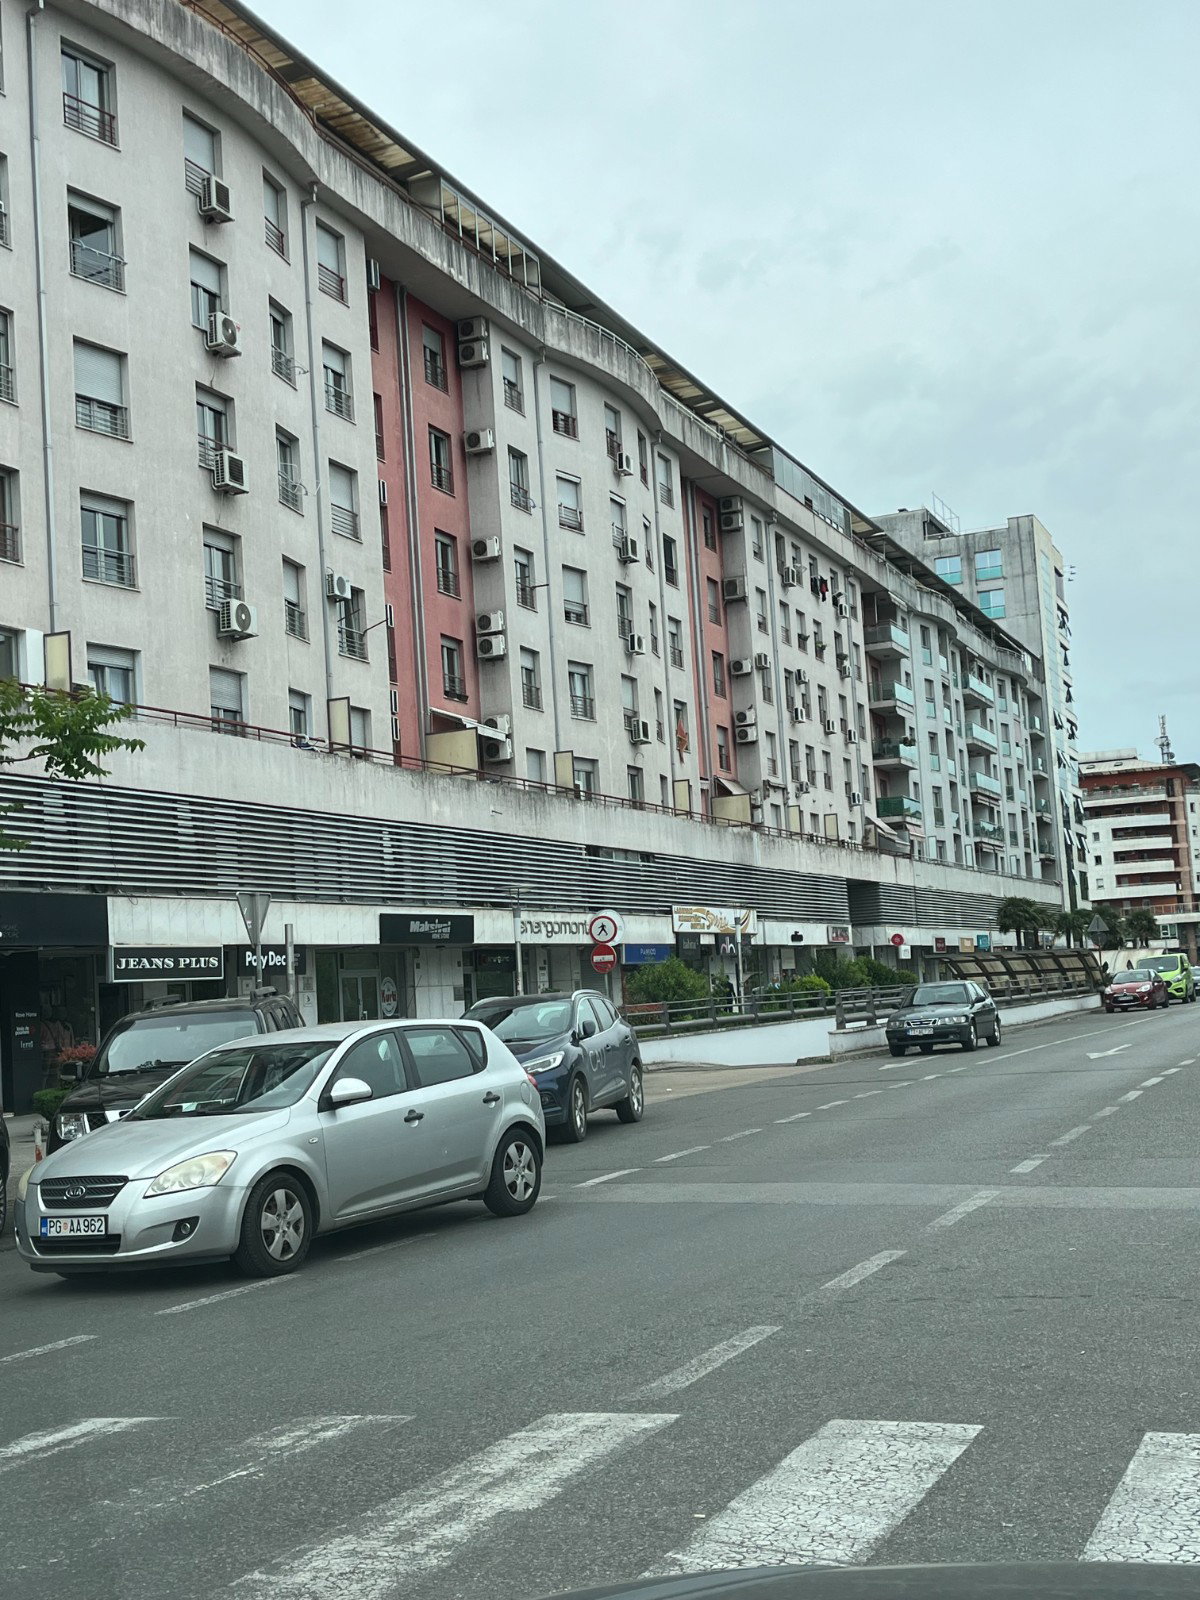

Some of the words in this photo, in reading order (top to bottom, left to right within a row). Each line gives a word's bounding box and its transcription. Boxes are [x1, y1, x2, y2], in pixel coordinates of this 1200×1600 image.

[520, 920, 590, 938] energomont
[116, 957, 175, 969] JEANS
[178, 956, 219, 969] PLUS
[245, 951, 268, 970] Poy
[49, 1219, 62, 1234] PG
[69, 1218, 104, 1234] AA962
